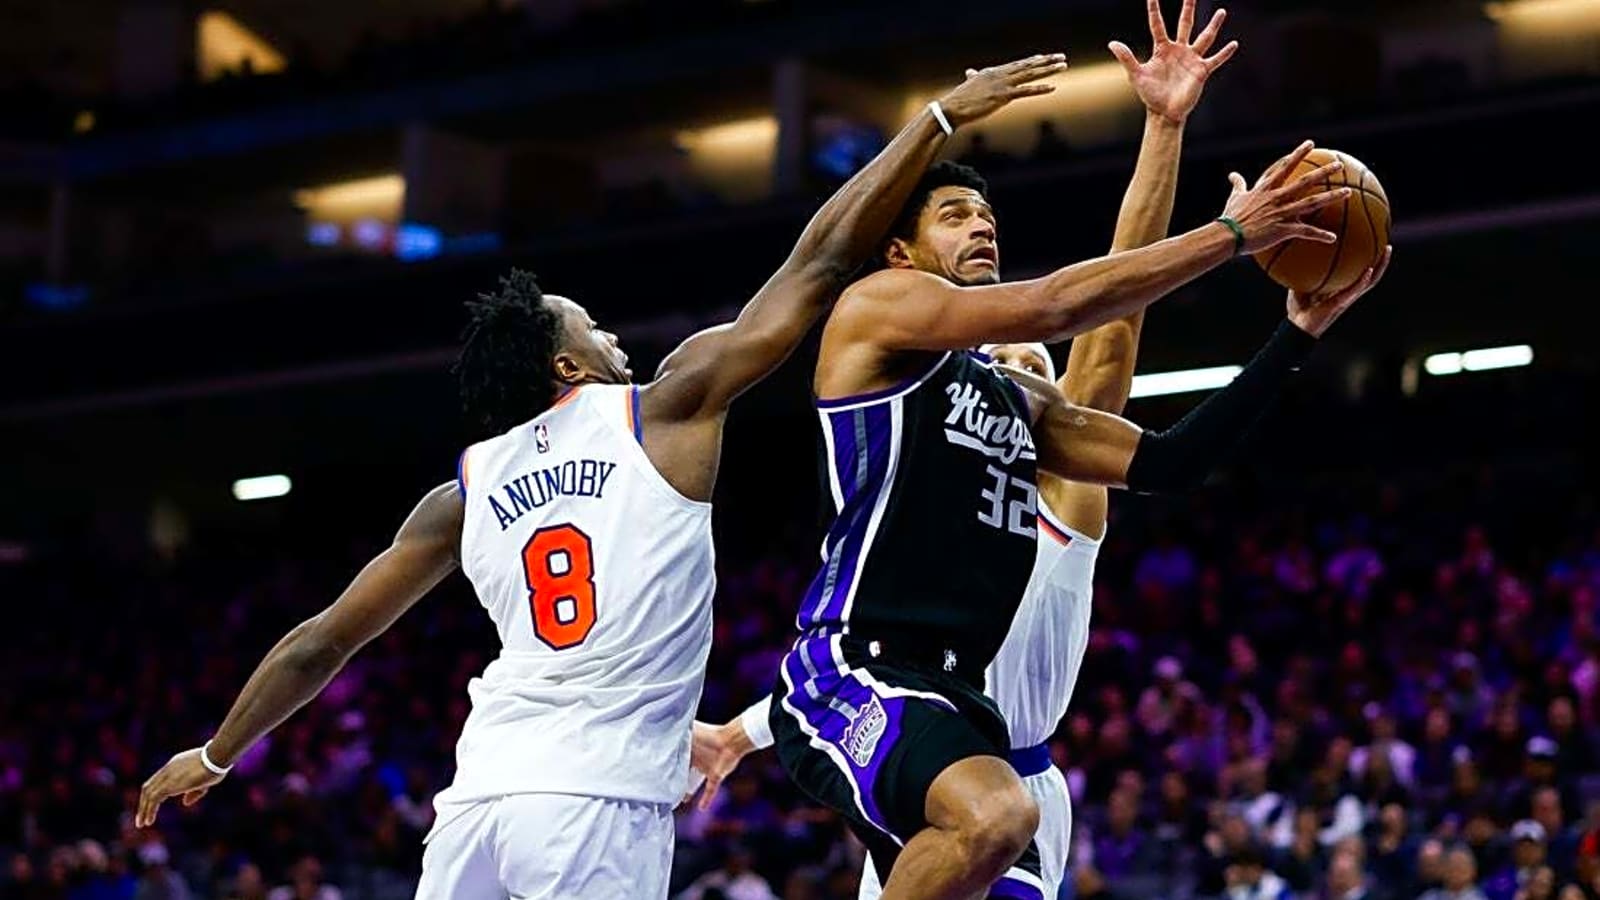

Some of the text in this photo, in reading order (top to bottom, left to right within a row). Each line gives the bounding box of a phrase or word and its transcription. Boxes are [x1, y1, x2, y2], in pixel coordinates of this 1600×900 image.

[488, 460, 616, 531] ANUNOBY
[977, 464, 1037, 539] 32
[521, 522, 598, 651] 8
